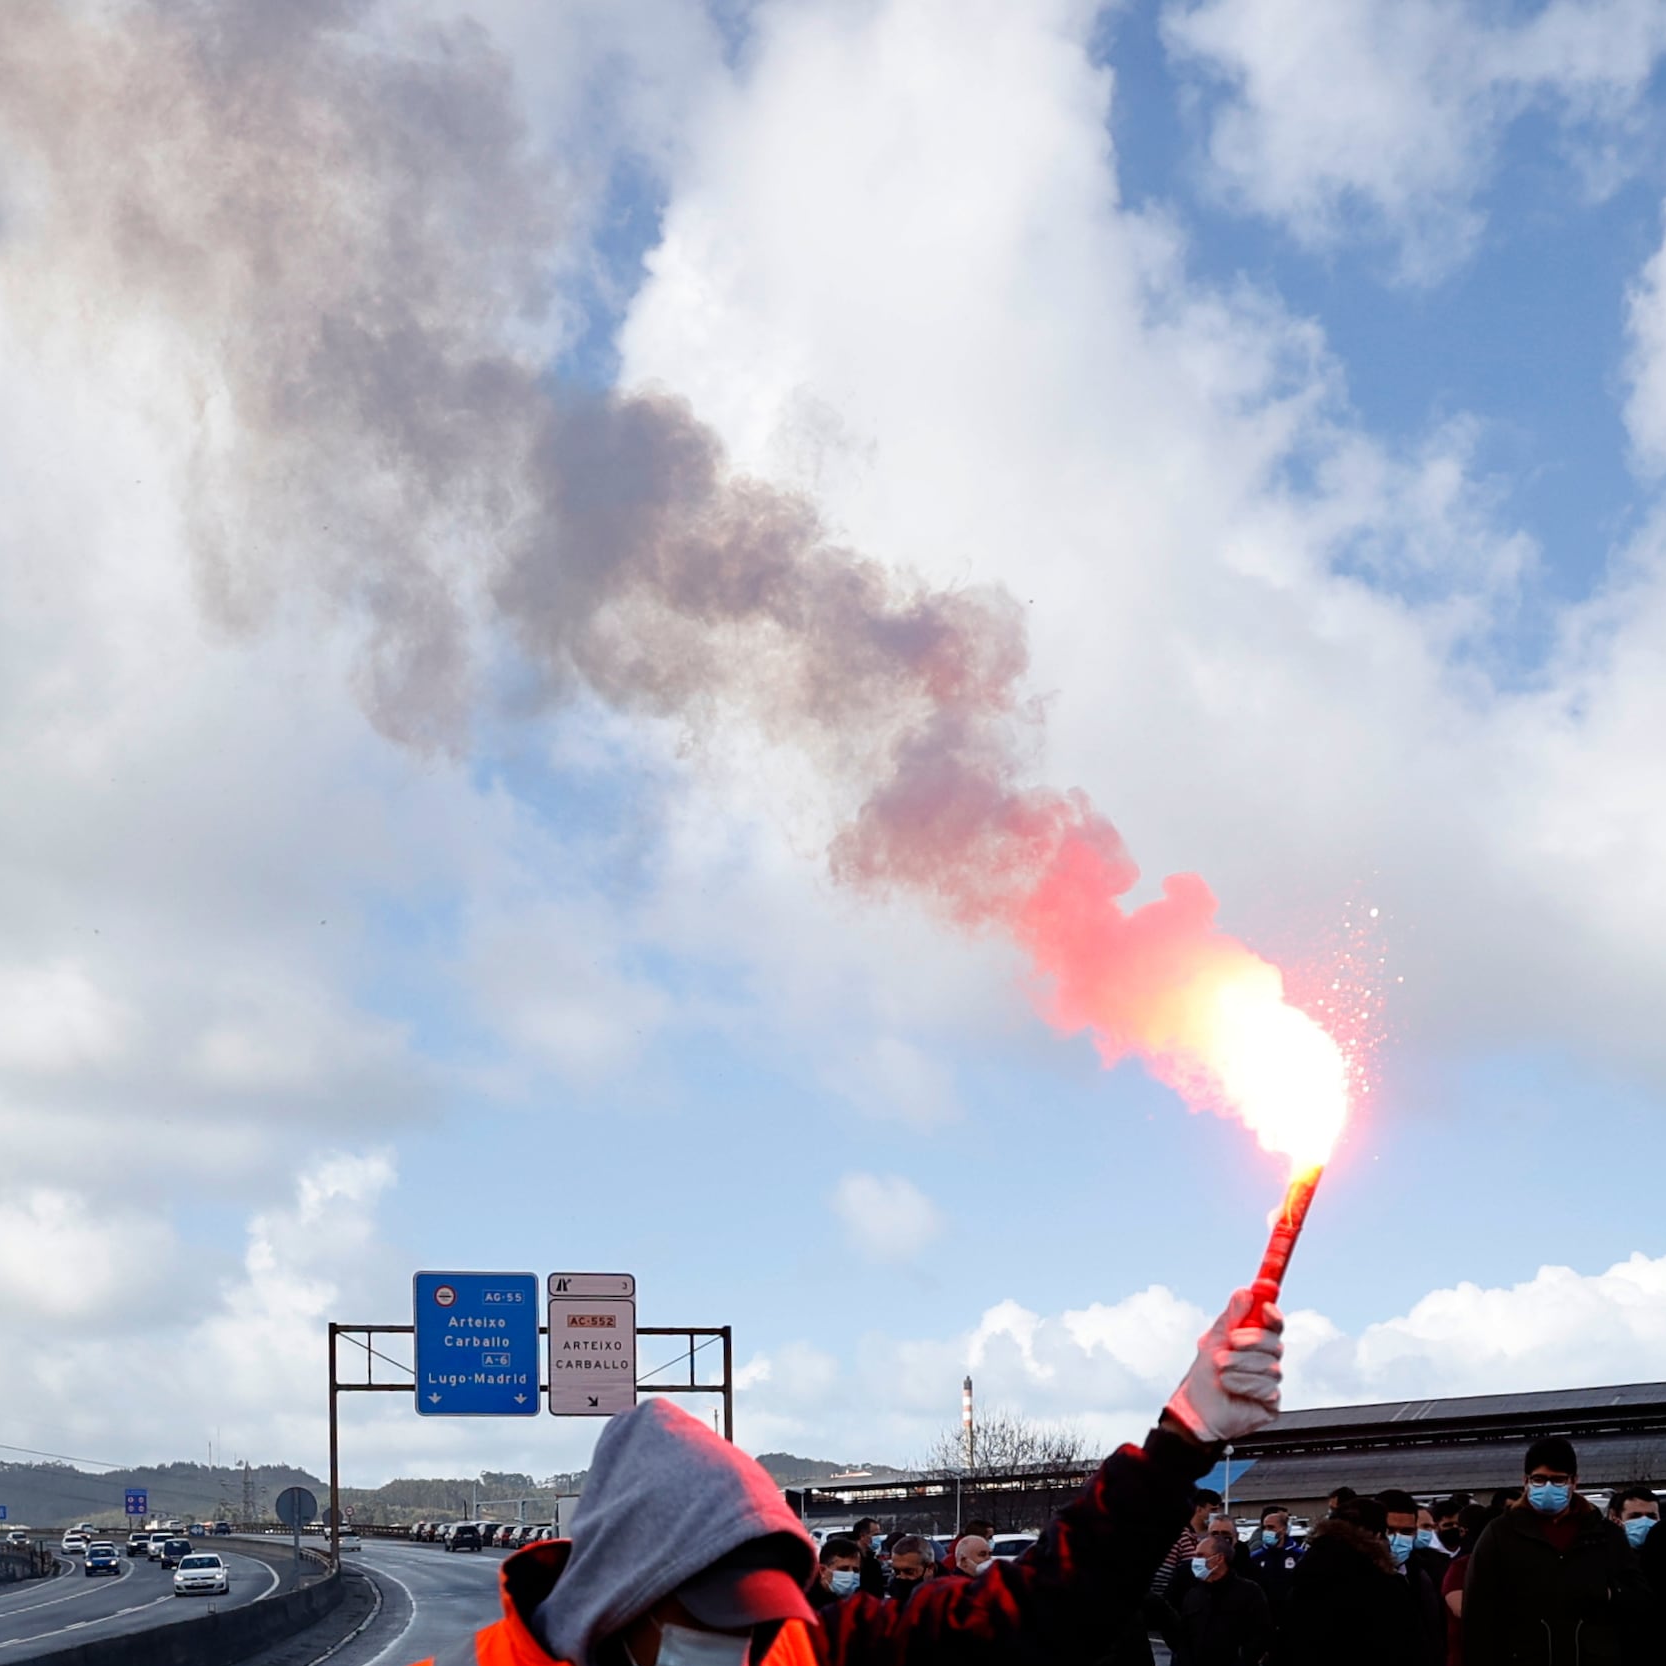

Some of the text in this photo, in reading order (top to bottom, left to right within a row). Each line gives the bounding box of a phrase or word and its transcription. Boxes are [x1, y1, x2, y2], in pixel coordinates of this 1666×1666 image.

[448, 1316, 506, 1328] Arteixo
[570, 1317, 614, 1326] AC-552
[444, 1335, 510, 1347] Carballo
[563, 1341, 622, 1351] ARTEIXO
[484, 1356, 508, 1365] A-6
[556, 1360, 629, 1369] CARBALLO
